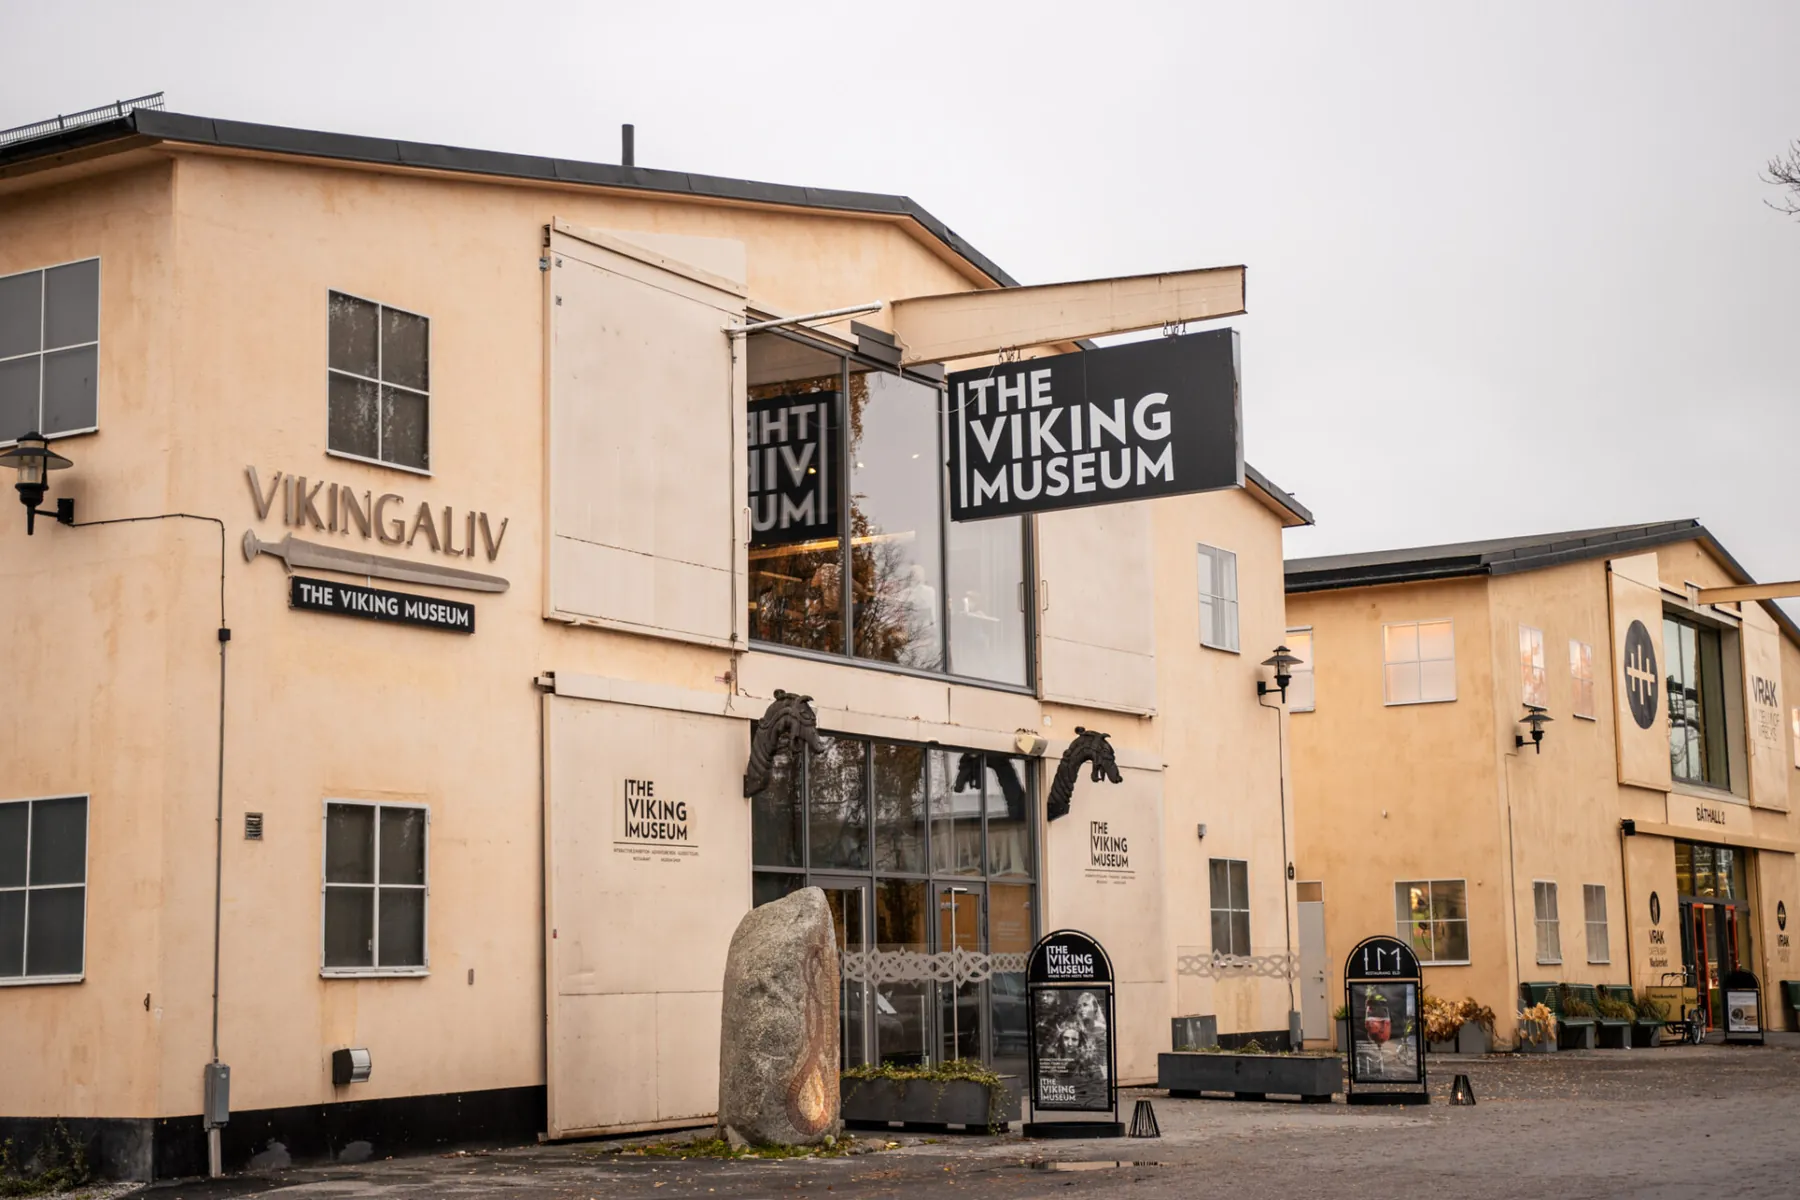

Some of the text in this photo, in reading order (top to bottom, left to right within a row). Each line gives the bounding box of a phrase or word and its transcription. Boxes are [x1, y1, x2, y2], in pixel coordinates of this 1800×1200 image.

[968, 368, 1053, 416] THE
[969, 392, 1172, 464] VIKING
[973, 441, 1175, 507] MUSEUM
[246, 464, 509, 561] VIKINGALIV
[300, 583, 469, 627] THE VIKING MUSEUM
[1751, 675, 1778, 708] VRAK
[628, 779, 654, 797] THE
[628, 798, 687, 821] VIKING
[629, 821, 688, 841] MUSEUM
[1092, 821, 1108, 834] THE
[1093, 835, 1128, 853] VIKING
[1093, 853, 1129, 868] MUSEUM
[1048, 945, 1068, 954] THE
[1050, 954, 1093, 965] VIKING
[1050, 965, 1094, 974] MUSEUM
[1042, 1085, 1075, 1094] VIKING
